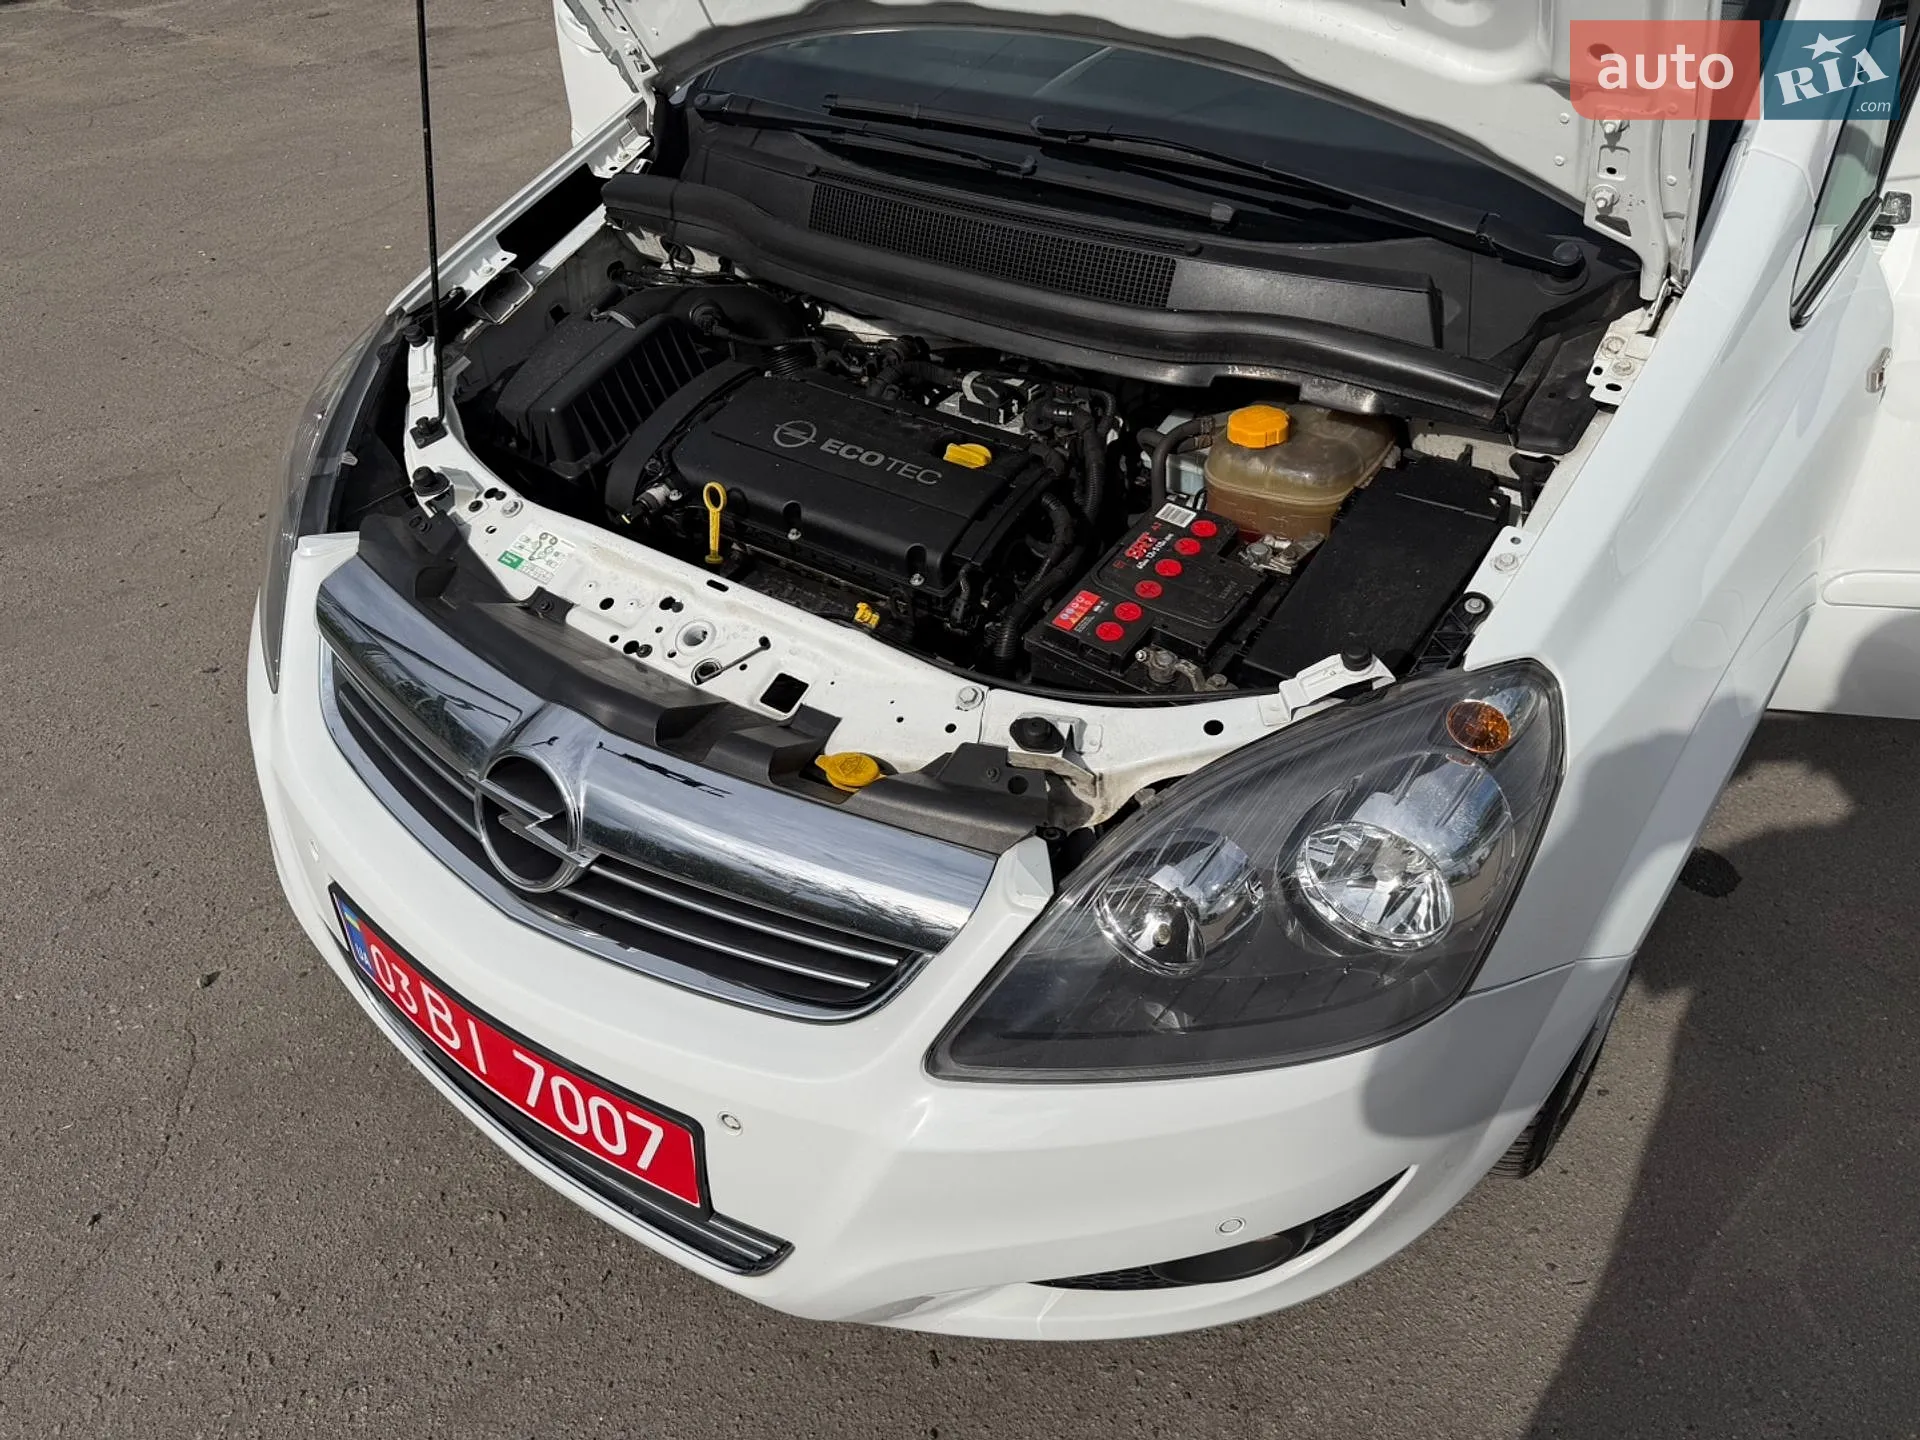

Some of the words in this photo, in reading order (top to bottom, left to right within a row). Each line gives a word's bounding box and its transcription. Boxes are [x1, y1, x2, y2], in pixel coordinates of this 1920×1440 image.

[820, 438, 943, 486] ECOTEC
[354, 943, 373, 970] UA
[513, 1049, 665, 1171] 7007
